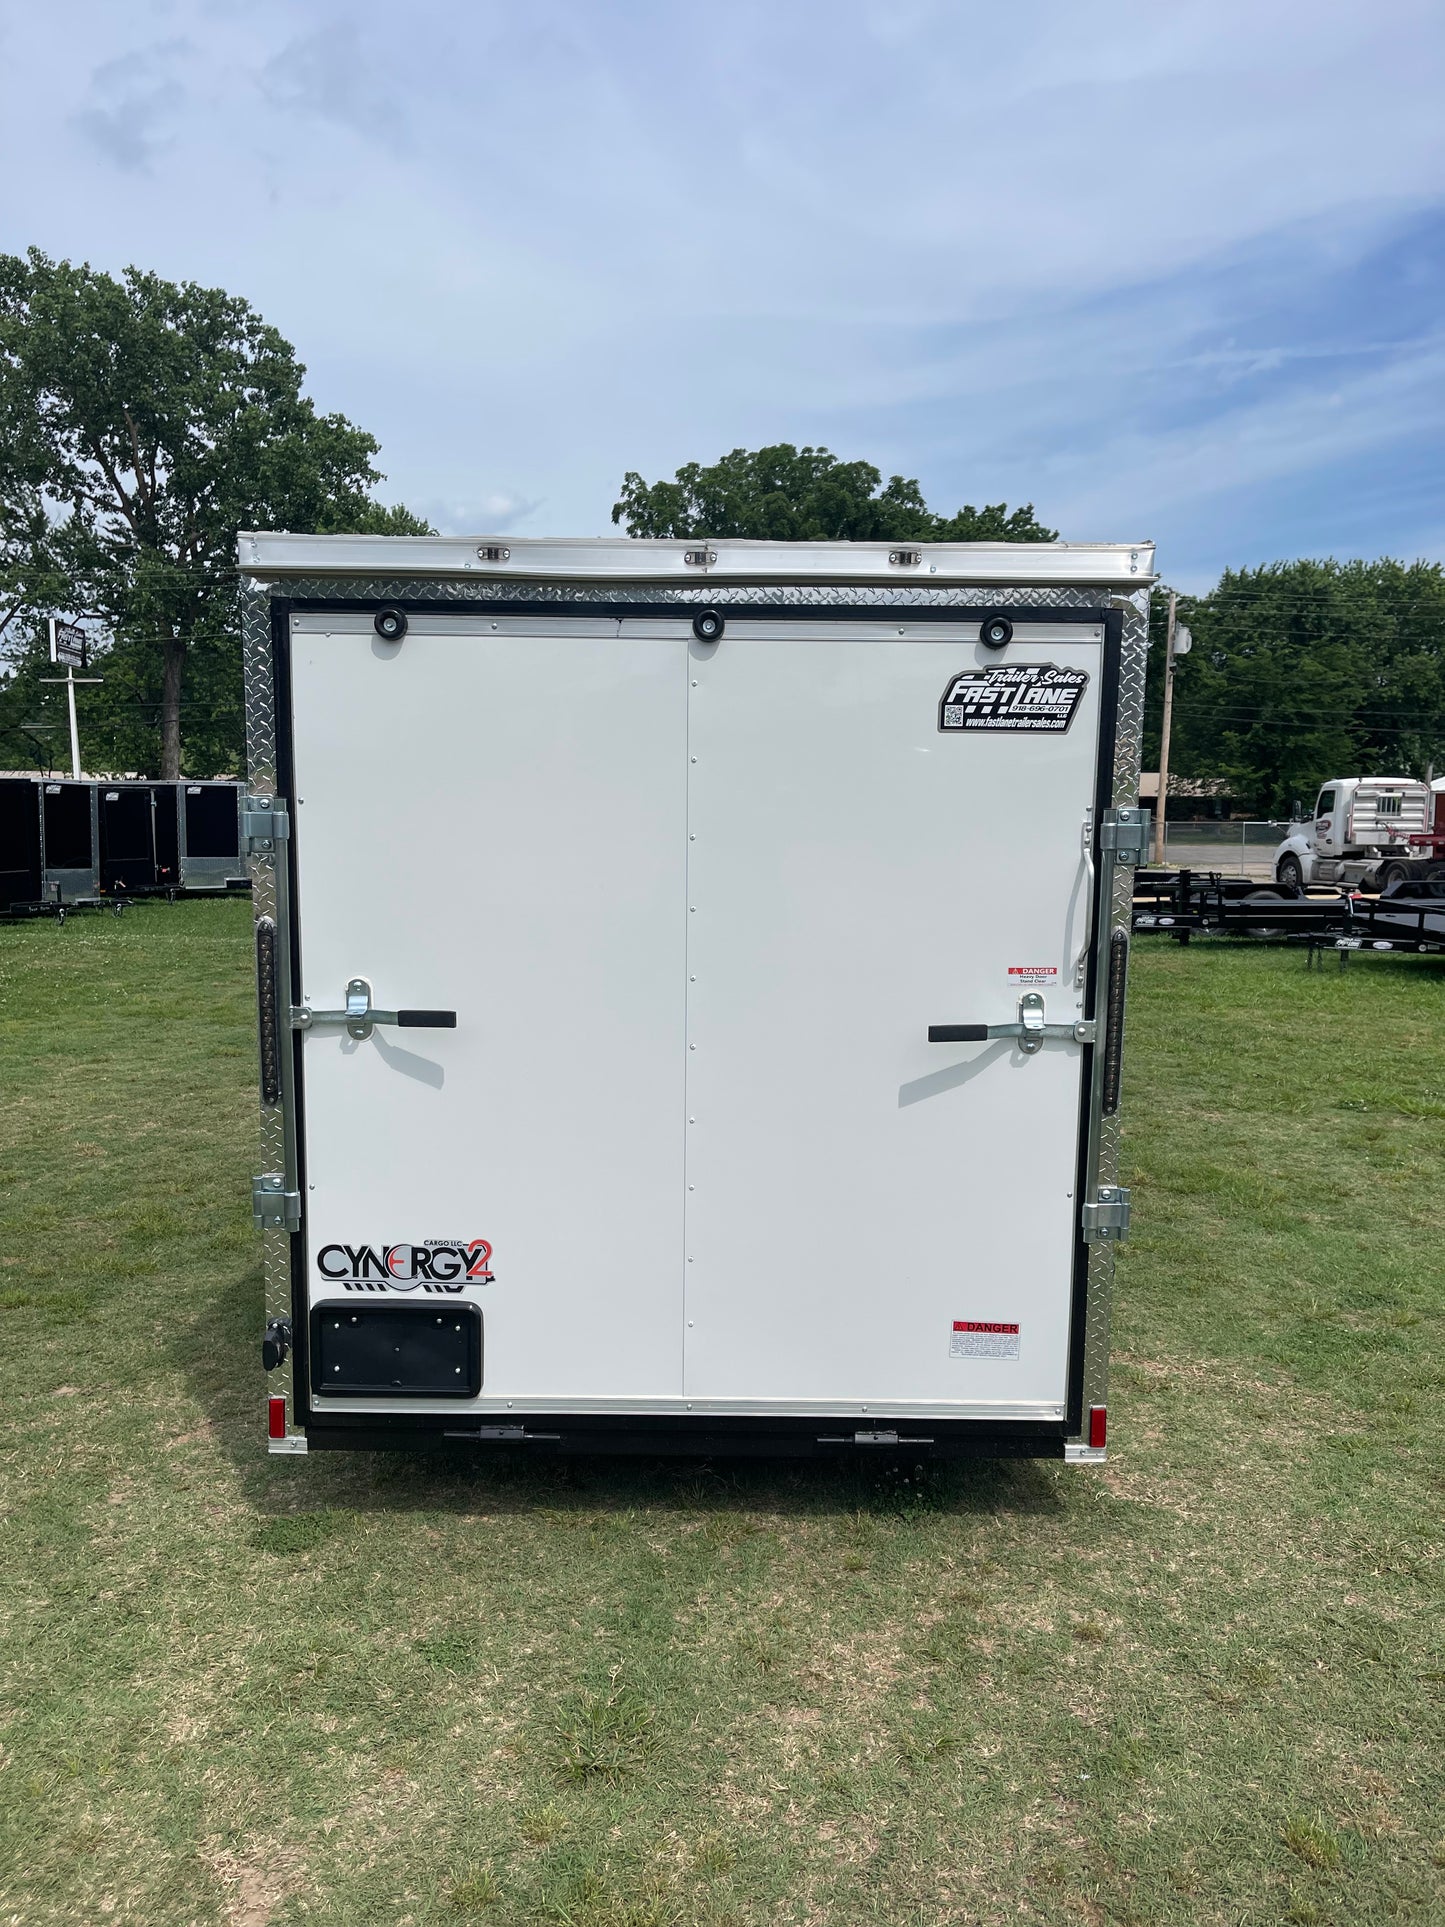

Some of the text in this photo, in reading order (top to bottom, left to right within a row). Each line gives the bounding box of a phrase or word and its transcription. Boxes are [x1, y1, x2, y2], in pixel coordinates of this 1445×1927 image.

[987, 669, 1085, 685] Trailer Sales
[966, 716, 1066, 729] www.fastlanetrailersales.com
[423, 1239, 450, 1247] CARGO
[966, 1322, 1019, 1334] DANGER
